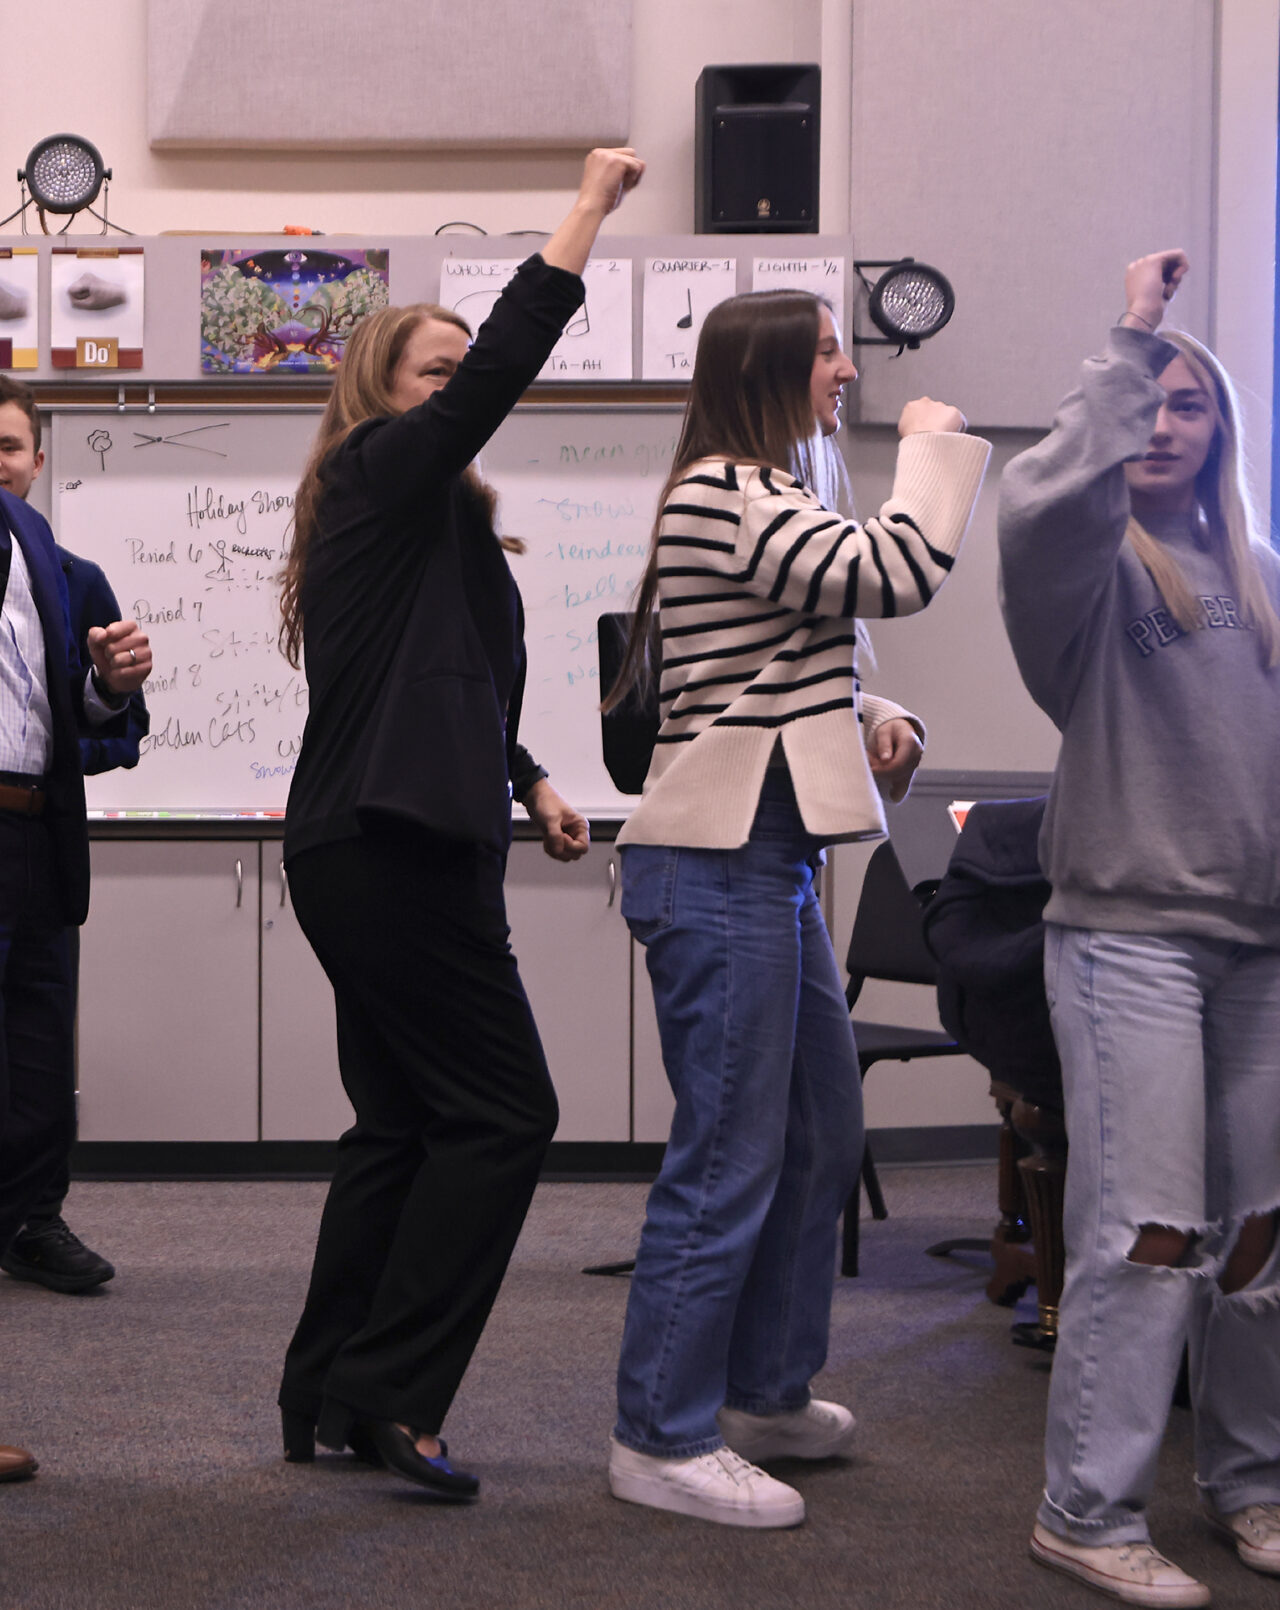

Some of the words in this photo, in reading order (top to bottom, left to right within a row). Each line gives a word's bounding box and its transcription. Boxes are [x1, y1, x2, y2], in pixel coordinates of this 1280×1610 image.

[187, 485, 247, 535] Holiday
[125, 538, 177, 565] Period
[133, 597, 185, 631] Period
[193, 602, 203, 622] 7
[188, 664, 202, 687] 8
